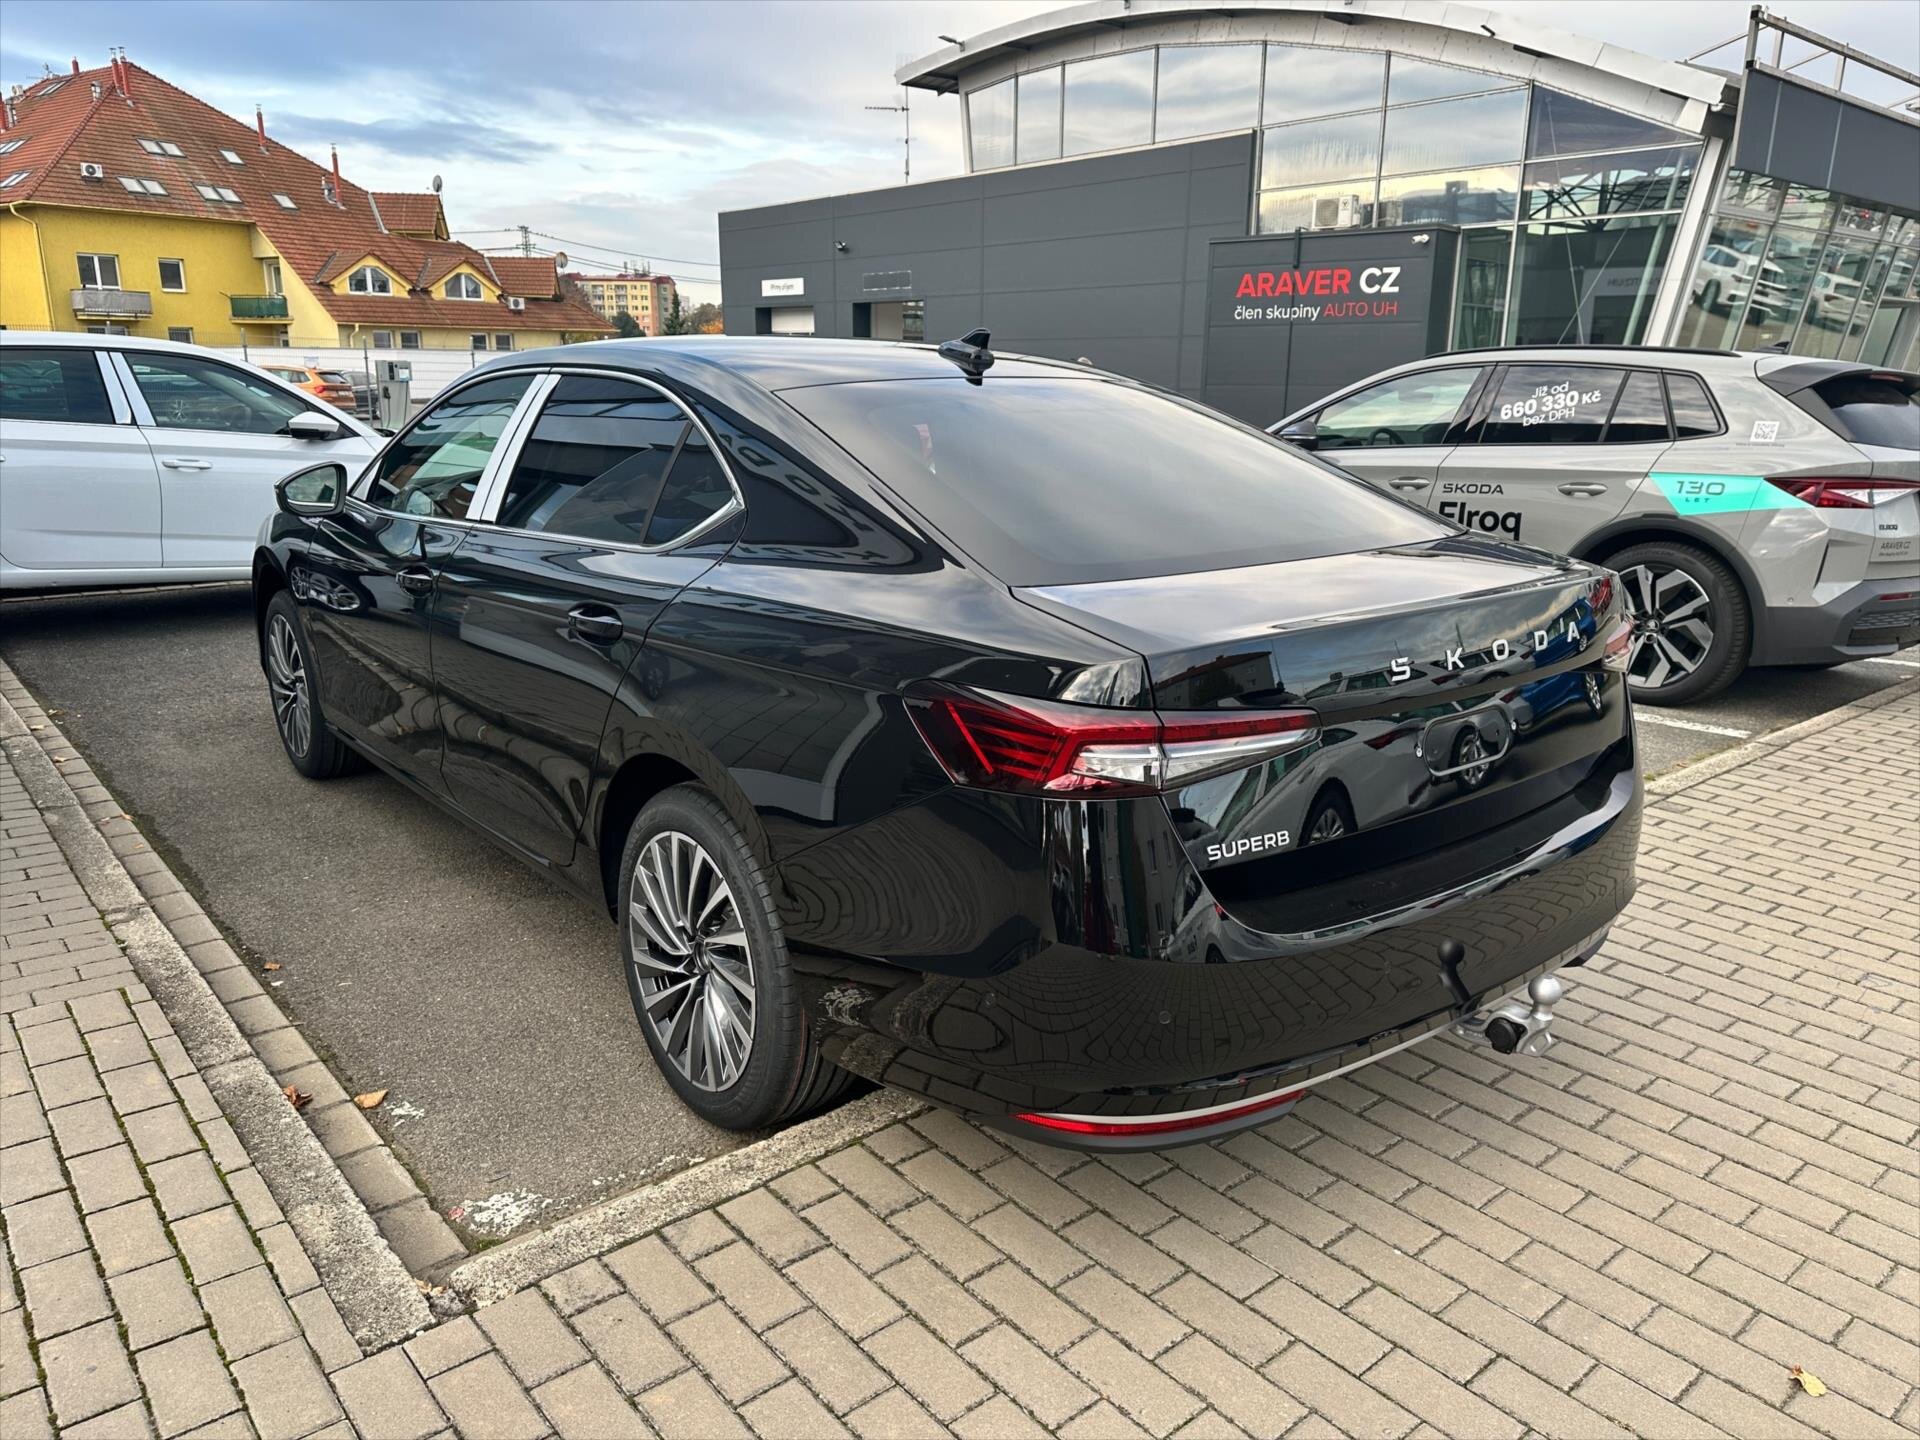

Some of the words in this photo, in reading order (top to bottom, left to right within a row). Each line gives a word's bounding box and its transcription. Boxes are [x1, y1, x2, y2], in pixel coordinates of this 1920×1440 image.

[1236, 268, 1352, 298] ARAVER
[1359, 266, 1401, 294] CZ
[1234, 305, 1263, 320] člen
[1266, 304, 1321, 322] skupiny
[1323, 302, 1368, 317] AUTO
[1373, 301, 1398, 316] UH
[1551, 381, 1569, 394] od
[1500, 399, 1537, 420] 660
[1541, 390, 1579, 412] 330
[1581, 389, 1602, 405] Kč
[1522, 414, 1546, 427] bez
[1548, 406, 1576, 421] DPH
[1677, 480, 1726, 496] 130
[1438, 501, 1522, 542] Elroq
[1206, 830, 1290, 861] SUPERB
